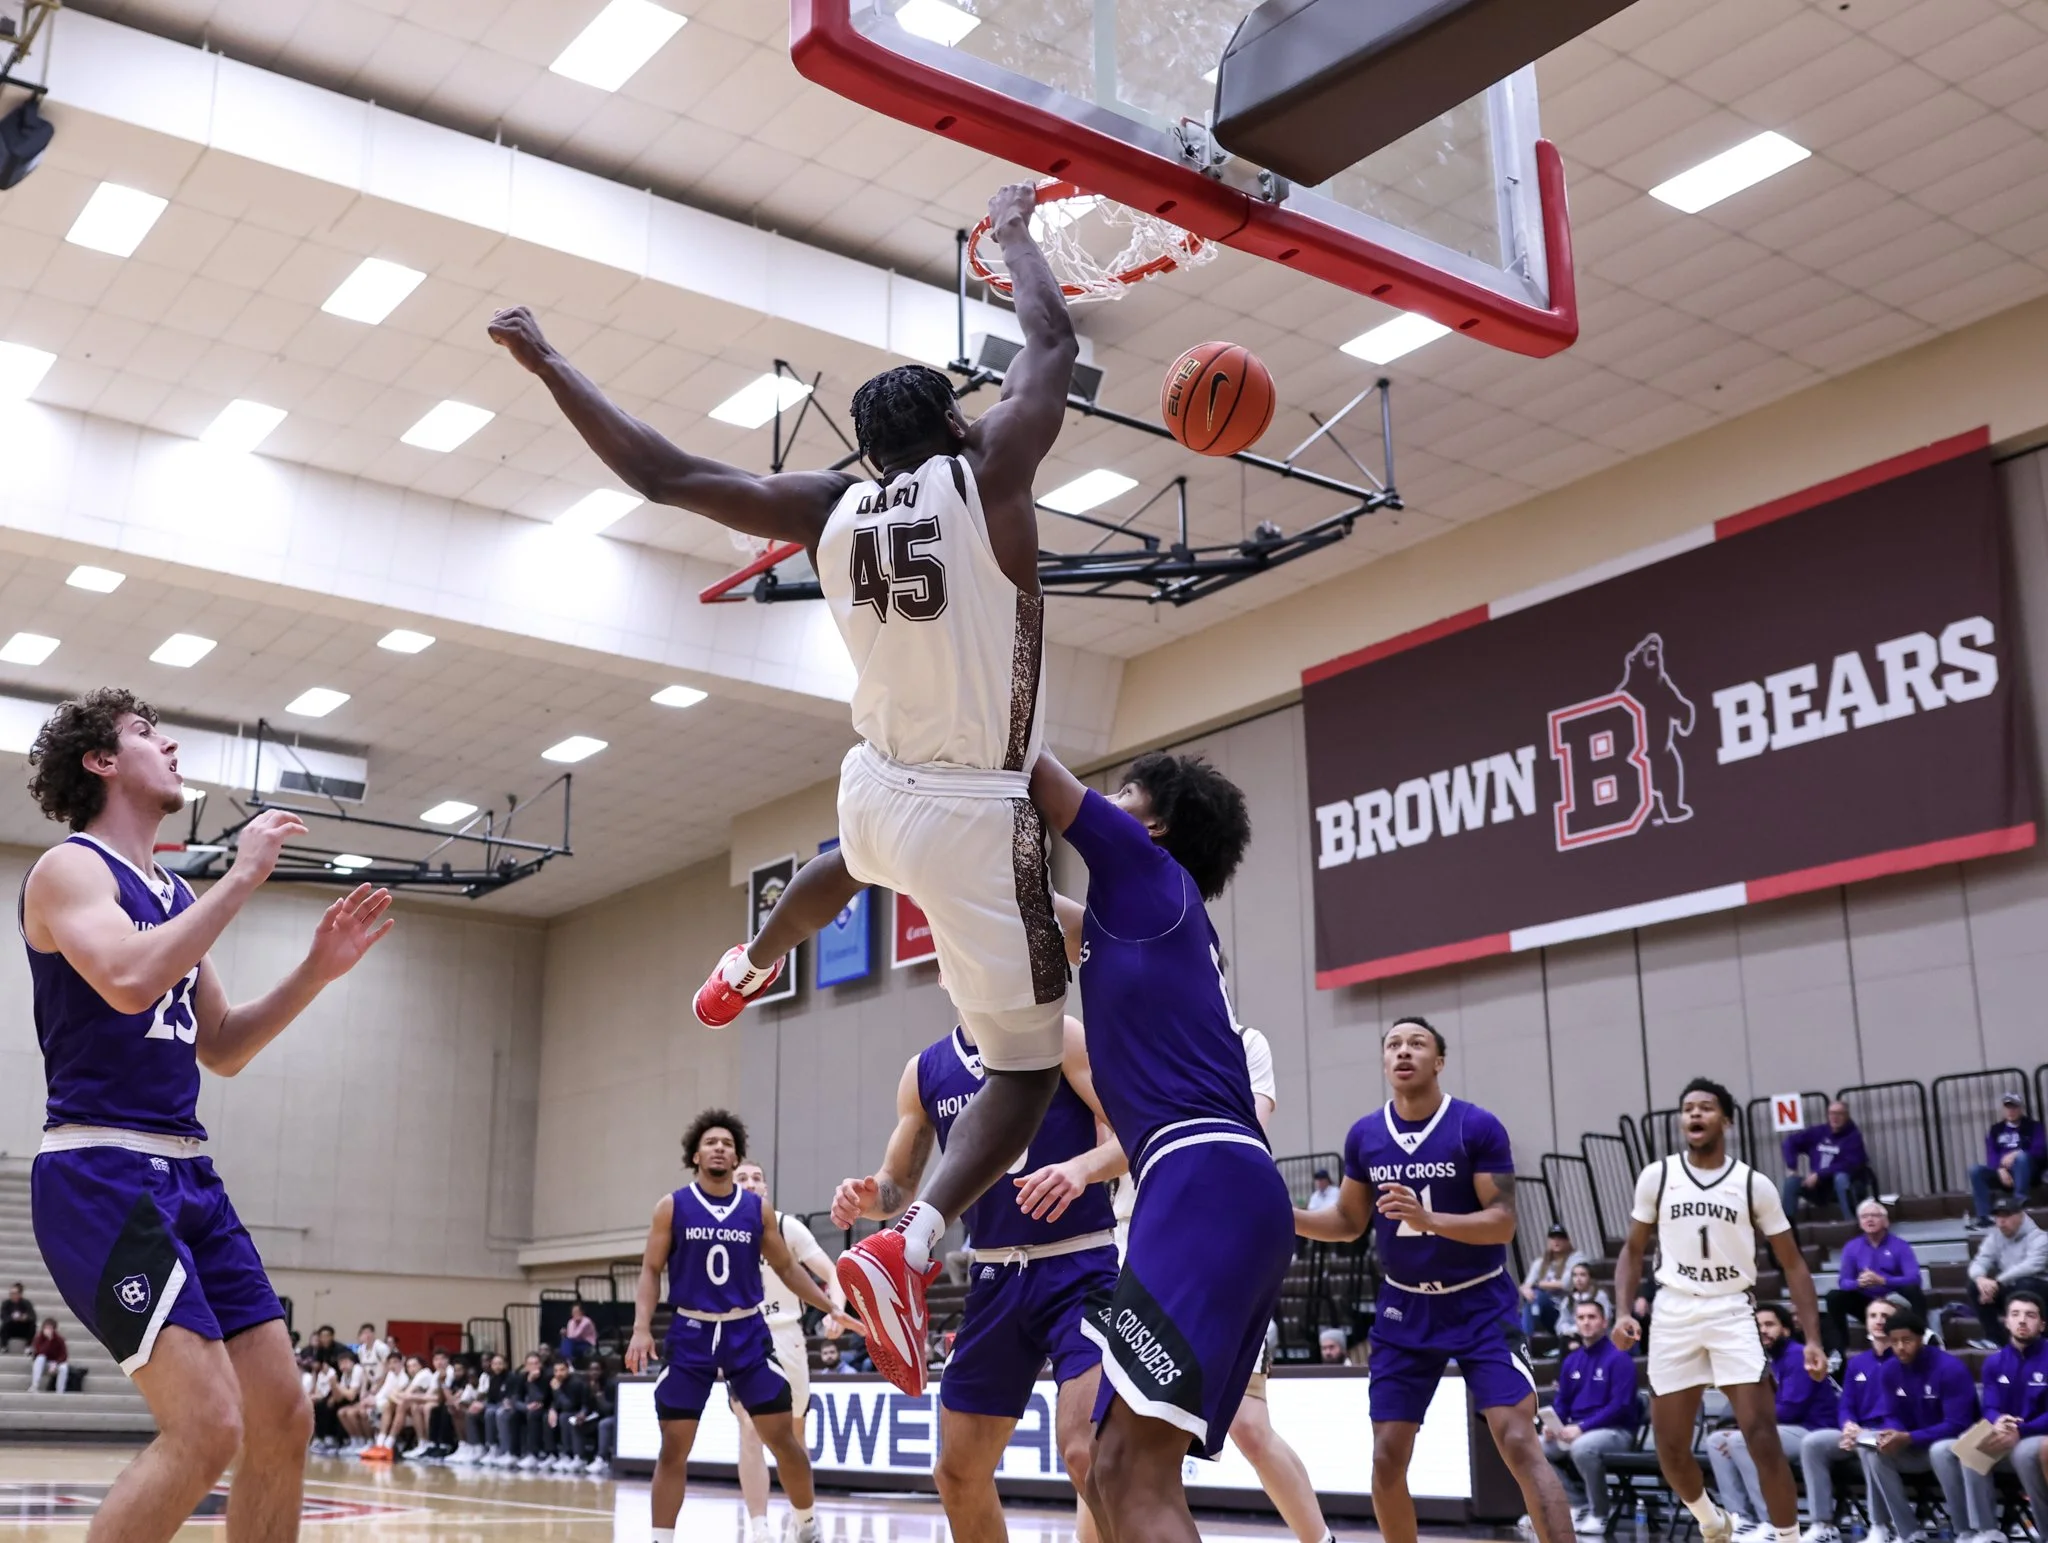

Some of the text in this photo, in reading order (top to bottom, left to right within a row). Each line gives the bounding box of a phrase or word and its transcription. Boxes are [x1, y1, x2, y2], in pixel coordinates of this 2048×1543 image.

[850, 515, 948, 623] 45
[1315, 744, 1537, 870] BROWN
[1712, 615, 1999, 765] BEARS
[1776, 1099, 1798, 1125] N
[1369, 1162, 1456, 1182] HOLY CROSS
[1670, 1201, 1738, 1225] BROWN
[685, 1227, 752, 1243] HOLY CROSS
[1698, 1224, 1710, 1260] 1
[706, 1244, 730, 1286] 0
[1676, 1262, 1740, 1283] BEARS
[1115, 1308, 1182, 1386] CRUSADERS
